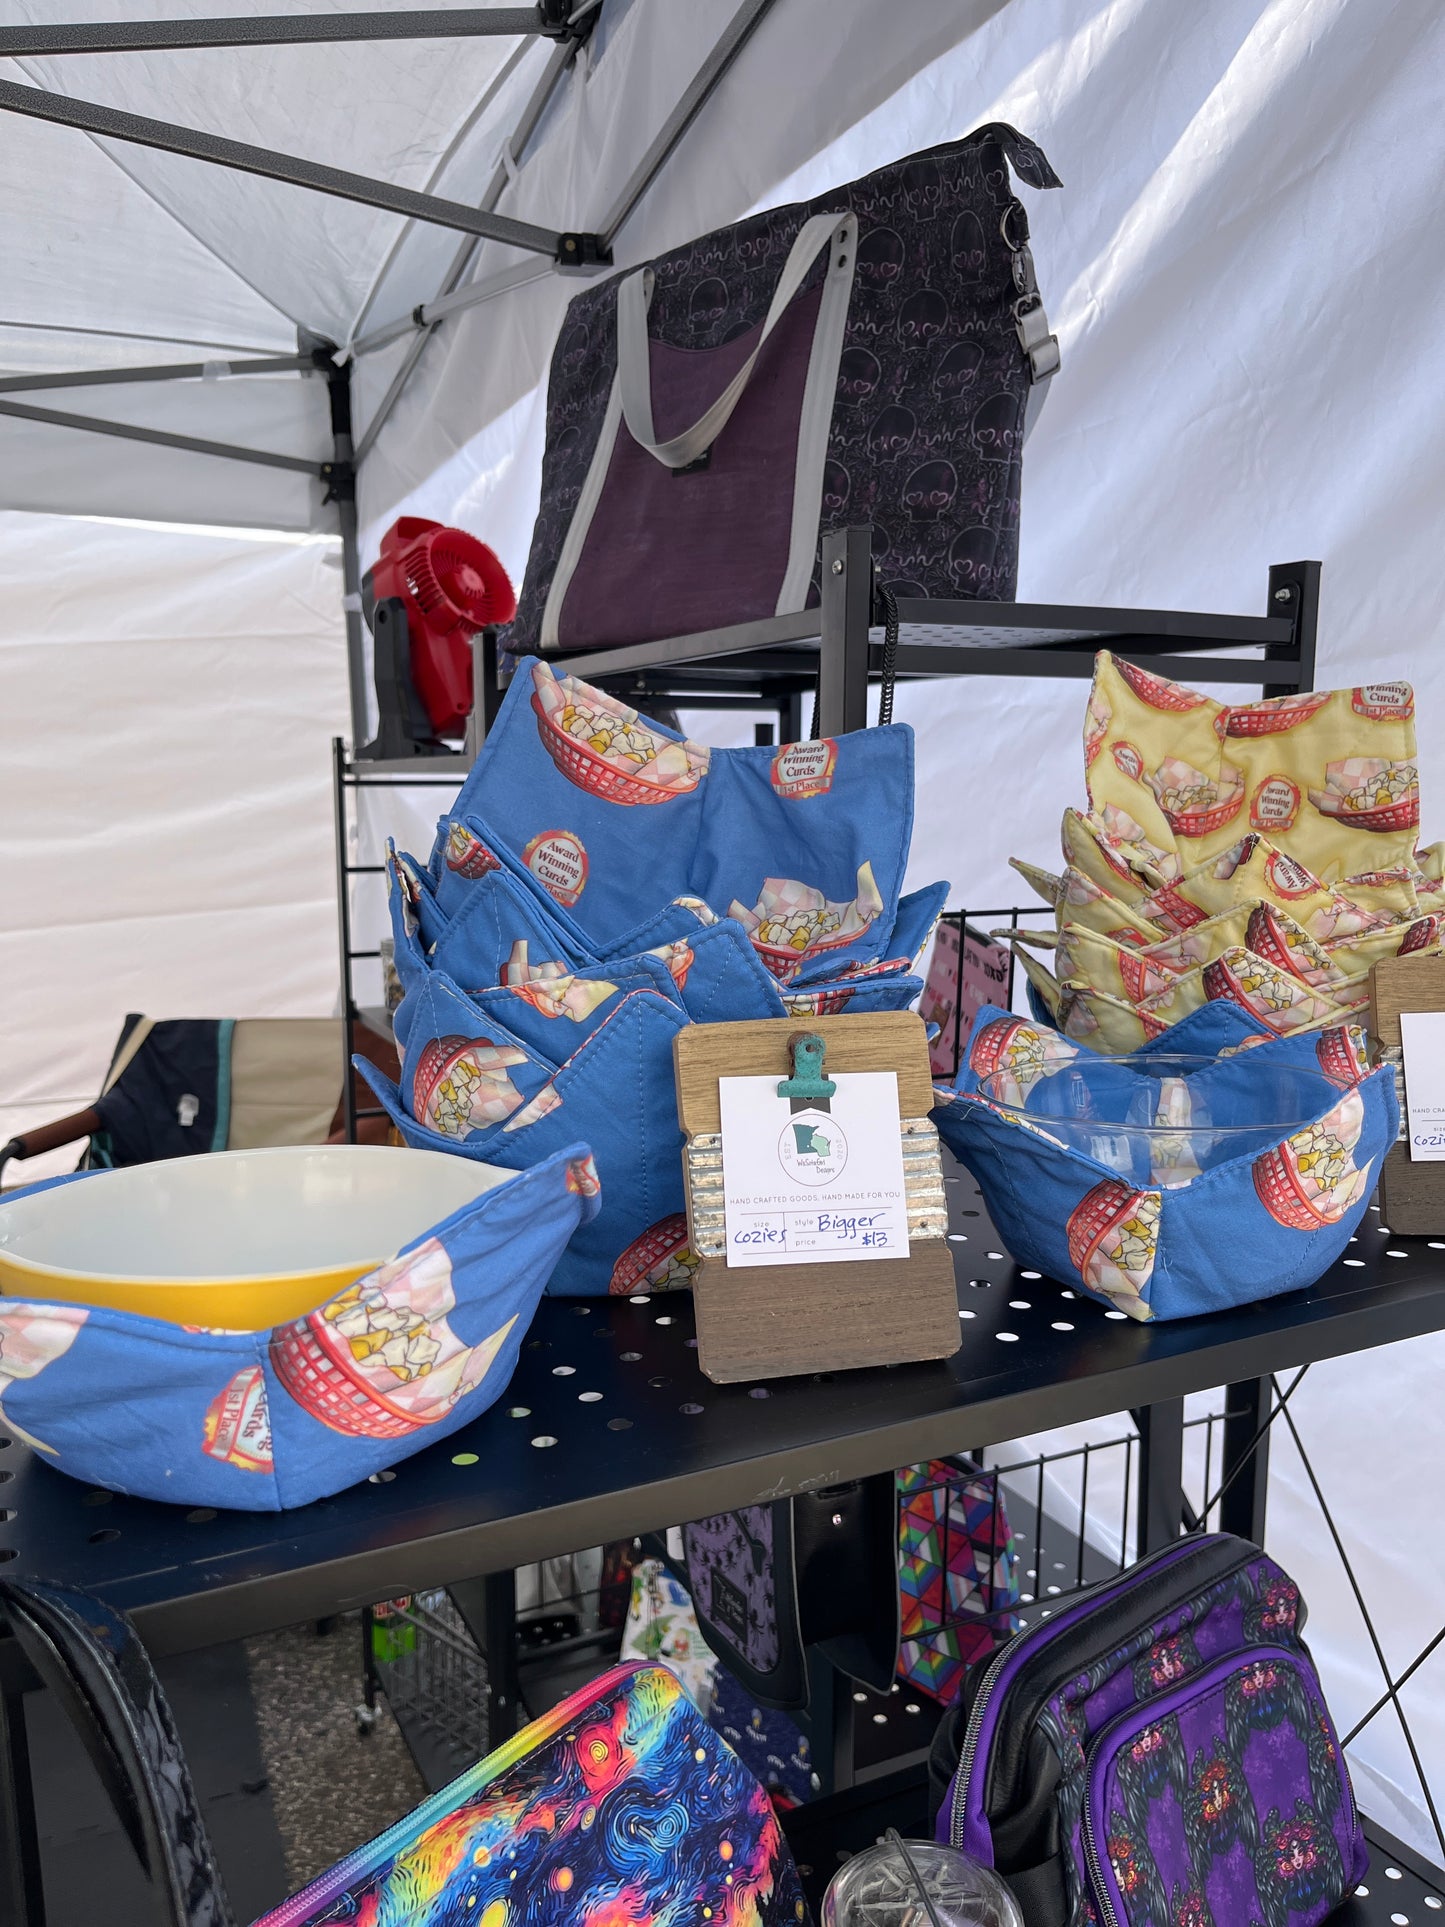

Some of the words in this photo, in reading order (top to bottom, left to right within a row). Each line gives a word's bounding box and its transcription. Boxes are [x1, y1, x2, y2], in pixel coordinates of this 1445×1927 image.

[1370, 693, 1399, 704] Curds
[792, 744, 825, 755] Award
[783, 754, 825, 765] Winning
[786, 765, 816, 777] Curds
[796, 780, 820, 791] Place
[547, 841, 580, 863] Award
[538, 849, 580, 879] Winning
[538, 865, 569, 887] Curds
[1275, 861, 1298, 889] Award
[730, 1196, 751, 1205] HAND
[753, 1195, 787, 1204] CRAFTED
[822, 1193, 843, 1201] HAND
[844, 1192, 865, 1200] MADE
[867, 1191, 882, 1199] FOR
[794, 1218, 814, 1227] style
[817, 1212, 886, 1240] Bigger
[795, 1238, 816, 1247] price
[862, 1231, 888, 1247] $13
[227, 1389, 244, 1404] 1st
[218, 1408, 240, 1441] Place
